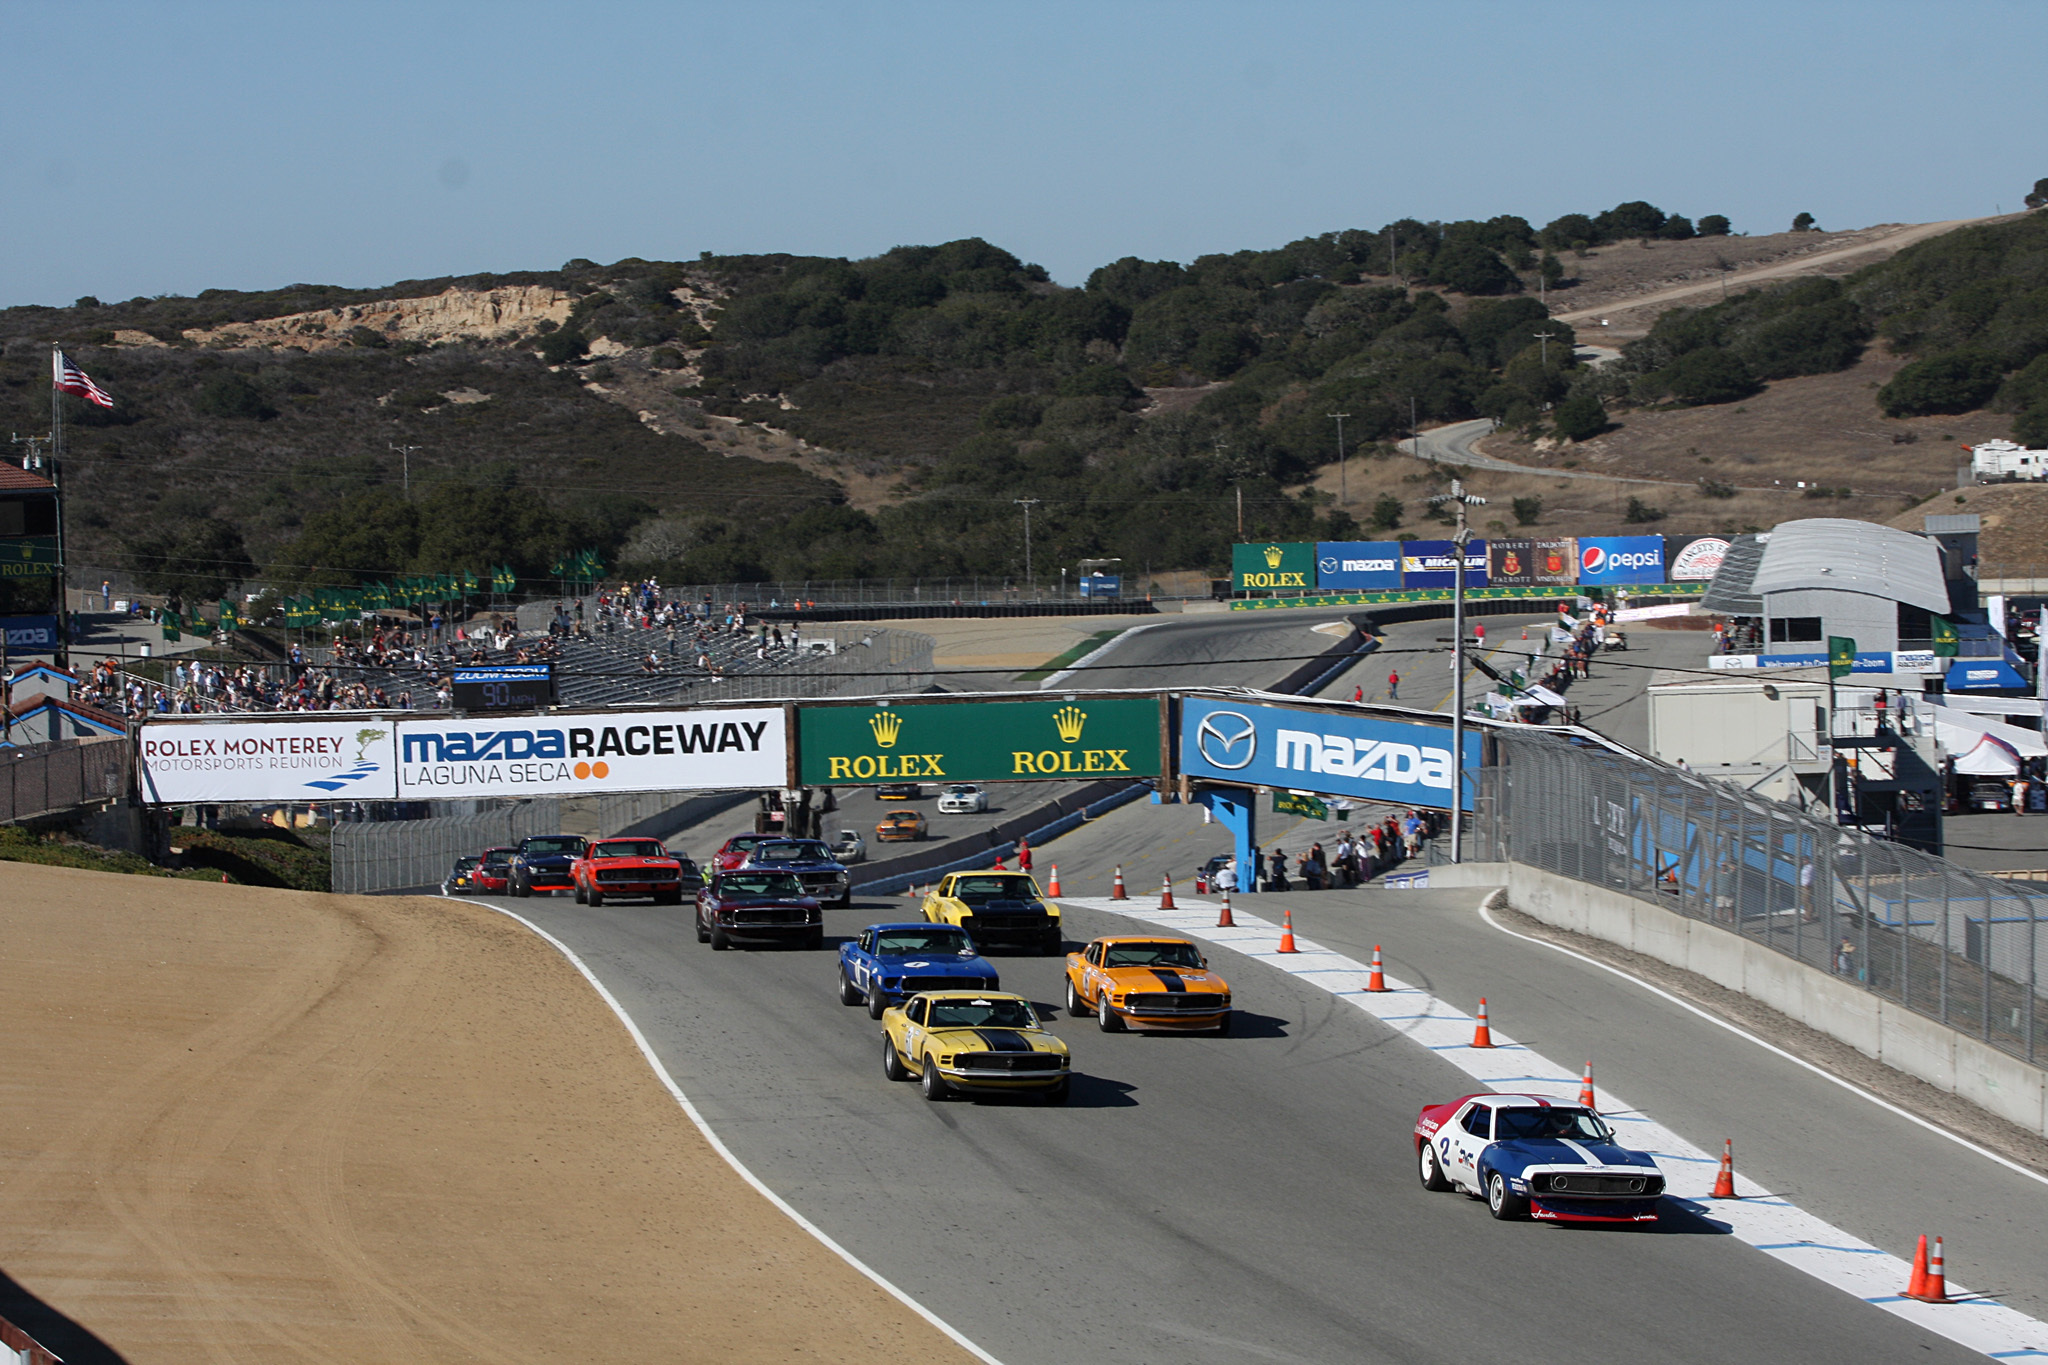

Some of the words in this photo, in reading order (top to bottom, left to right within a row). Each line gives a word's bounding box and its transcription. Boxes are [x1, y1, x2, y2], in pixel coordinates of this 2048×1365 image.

[2, 563, 54, 576] ROLEX
[1342, 559, 1395, 571] mazda
[1609, 549, 1661, 570] pepsi
[1242, 572, 1306, 587] ROLEX
[482, 683, 509, 706] 90
[511, 694, 537, 705] MPH
[145, 738, 216, 757] ROLEX
[224, 736, 344, 755] MONTEREY
[146, 757, 264, 772] MOTORSPORTS
[269, 756, 343, 769] REUNION
[828, 754, 946, 779] ROLEX
[1012, 749, 1131, 774] ROLEX
[1276, 728, 1454, 789] mazda
[403, 763, 504, 786] LAGUNA
[509, 761, 572, 783] SECA
[1440, 1136, 1450, 1167] 2
